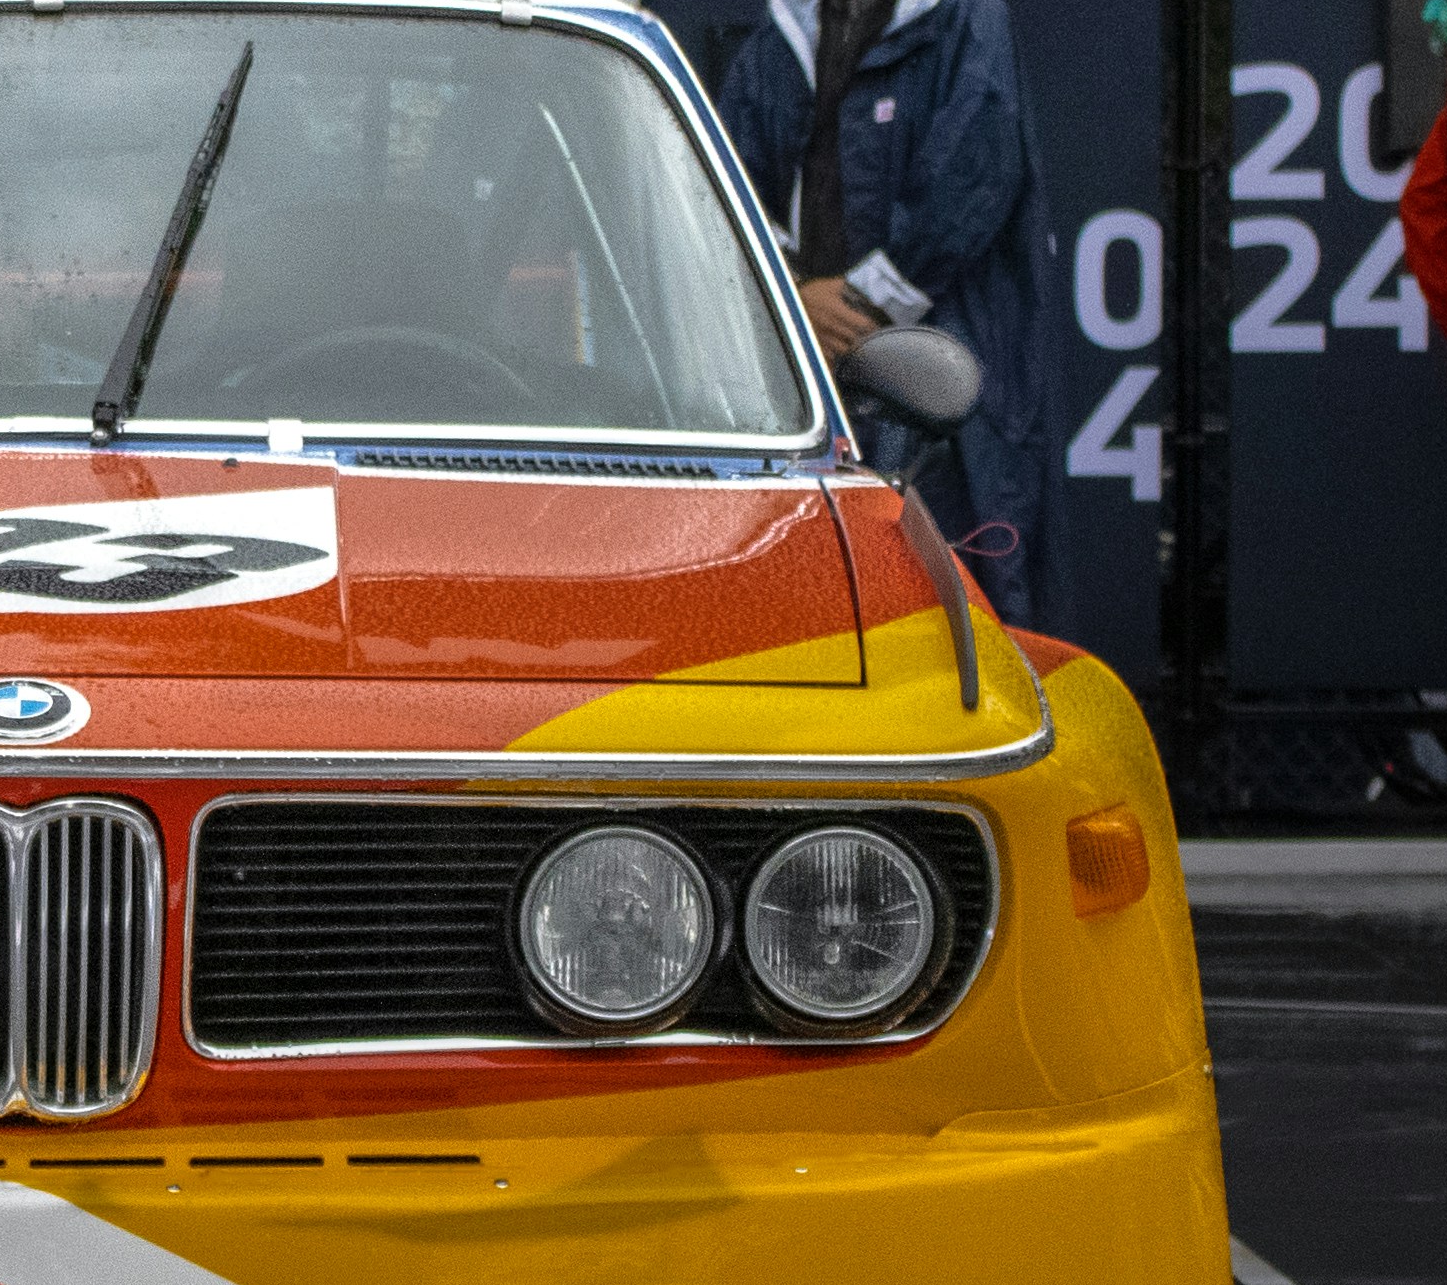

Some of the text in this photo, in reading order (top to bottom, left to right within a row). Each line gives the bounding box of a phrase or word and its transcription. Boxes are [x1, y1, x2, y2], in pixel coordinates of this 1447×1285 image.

[1073, 209, 1164, 351] 0
[1230, 214, 1429, 354] 24
[1066, 364, 1163, 502] 4
